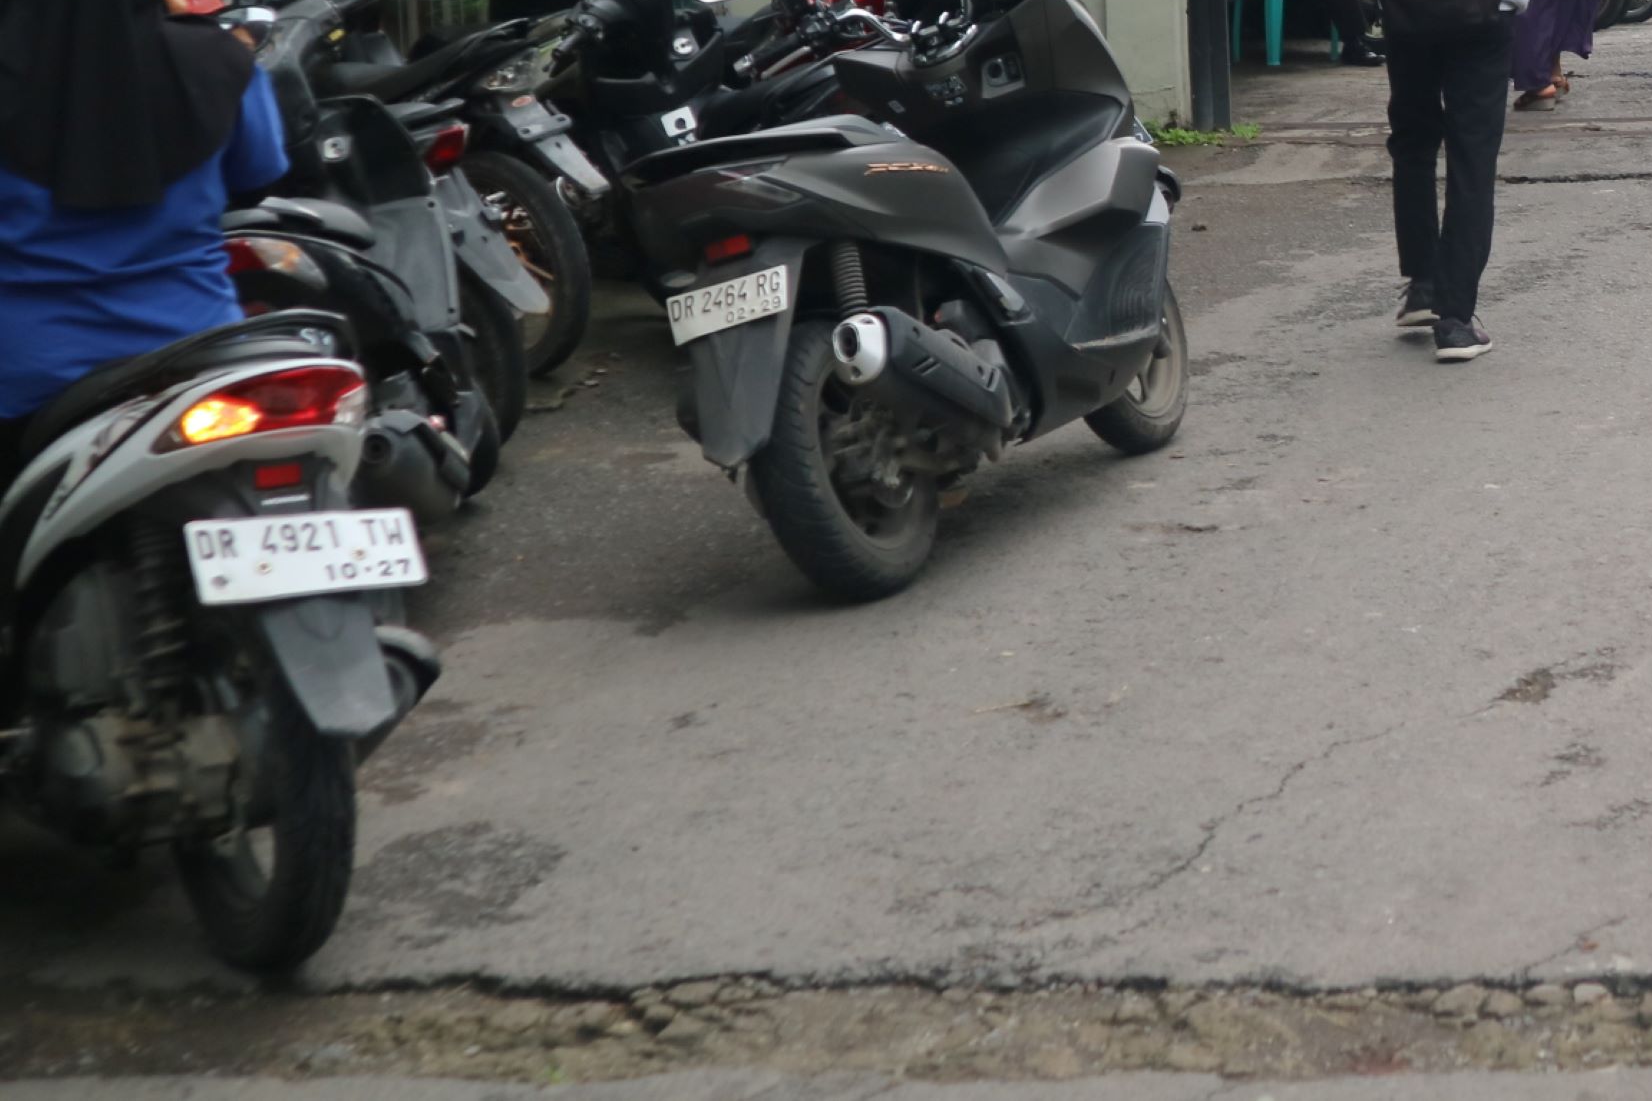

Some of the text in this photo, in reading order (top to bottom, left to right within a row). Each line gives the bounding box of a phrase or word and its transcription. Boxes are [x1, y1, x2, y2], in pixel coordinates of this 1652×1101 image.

[671, 271, 781, 322] DR 2464 RG
[195, 518, 405, 560] DR 4921 TW
